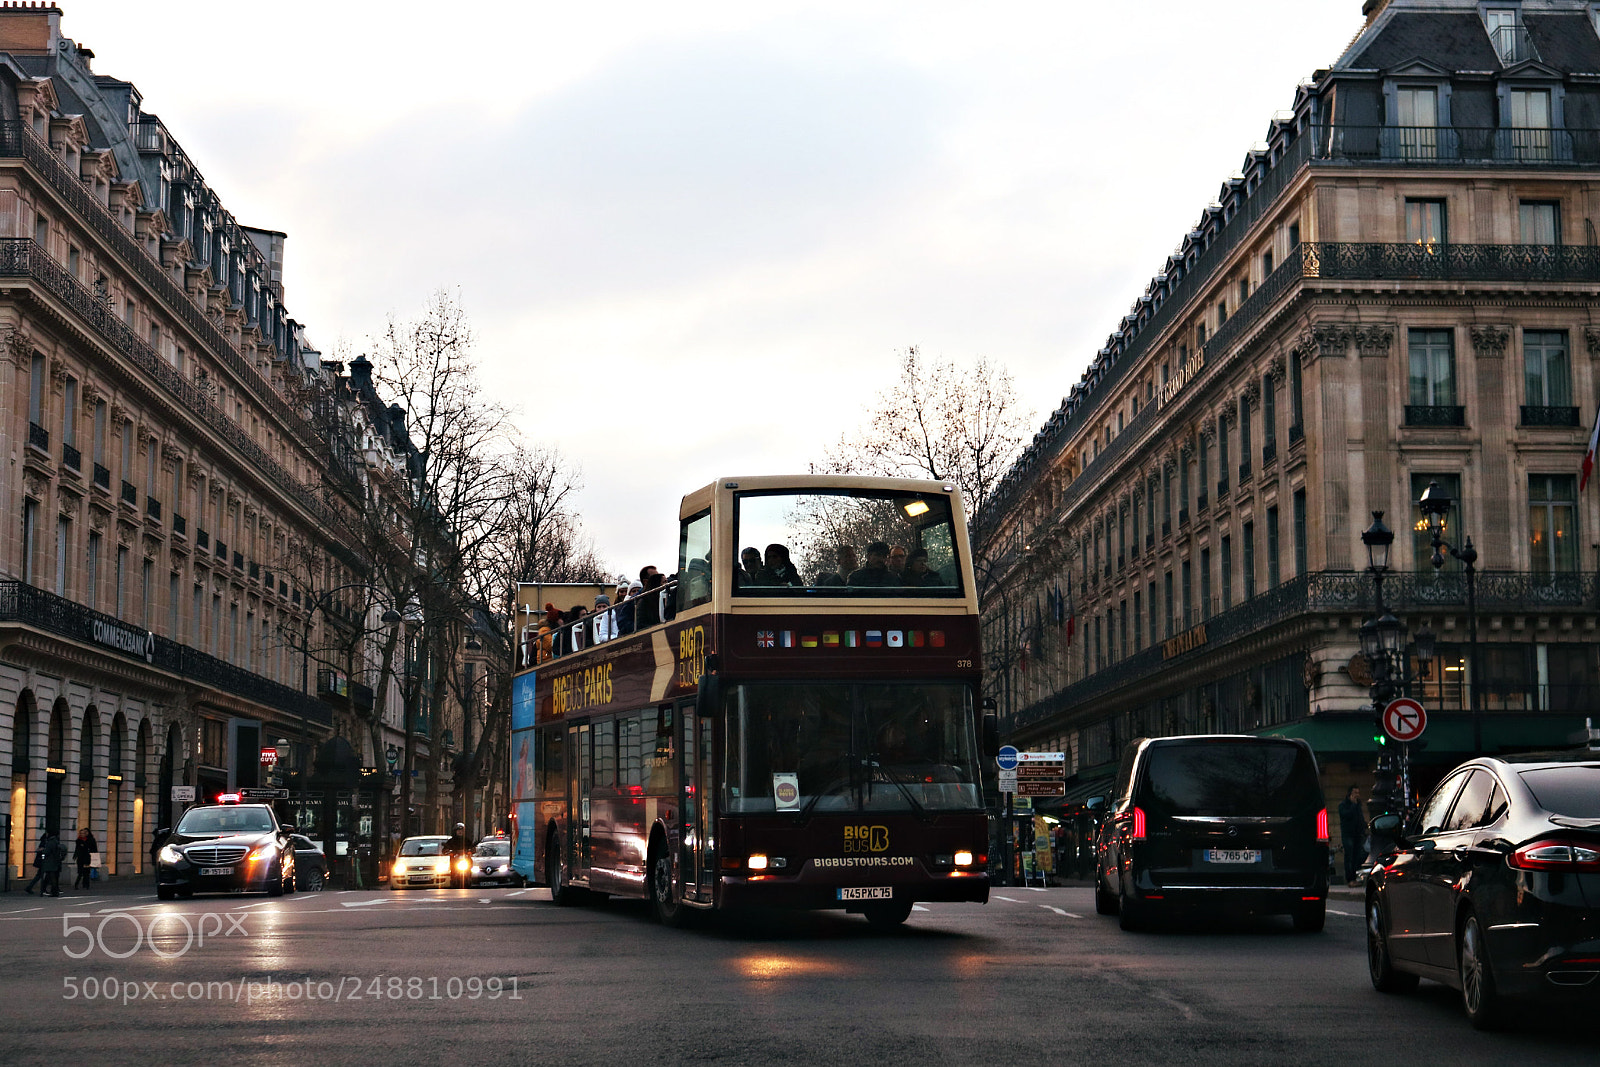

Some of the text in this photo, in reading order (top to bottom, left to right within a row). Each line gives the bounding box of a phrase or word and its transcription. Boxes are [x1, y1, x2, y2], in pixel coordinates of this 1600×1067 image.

[1165, 369, 1184, 403] GRAND
[93, 619, 145, 657] COMMERZBANK
[679, 628, 694, 660] BIG
[679, 659, 693, 688] BUS
[957, 659, 972, 668] 378
[584, 662, 613, 708] PARIS
[843, 839, 869, 853] BUS
[844, 825, 869, 839] BIG
[813, 856, 914, 867] BIGBUSTOURS.COM
